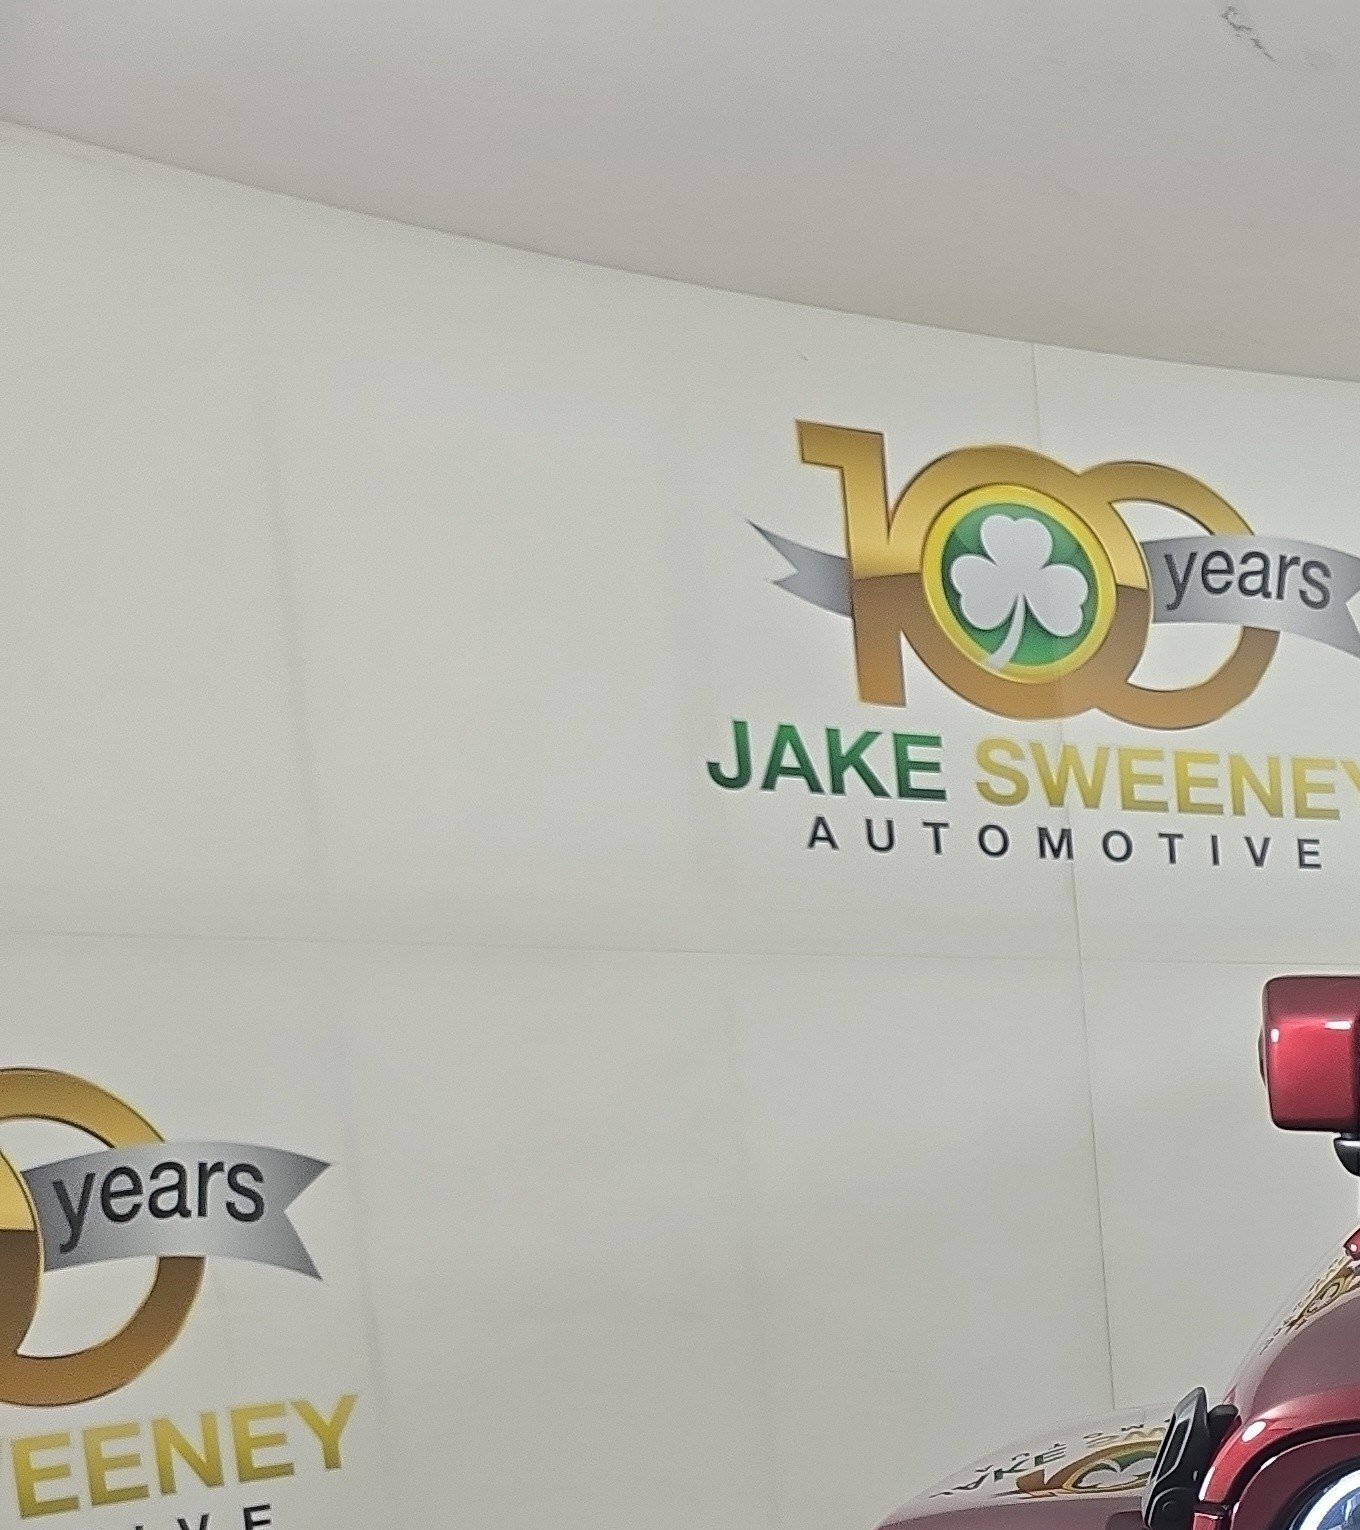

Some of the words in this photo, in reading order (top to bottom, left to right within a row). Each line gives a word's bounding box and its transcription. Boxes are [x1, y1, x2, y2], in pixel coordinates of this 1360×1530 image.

[1164, 548, 1333, 611] years
[706, 719, 947, 802] JAKE
[806, 816, 1324, 871] AUTOMOTIVE
[52, 1157, 266, 1256] years
[11, 1395, 358, 1519] EENEY
